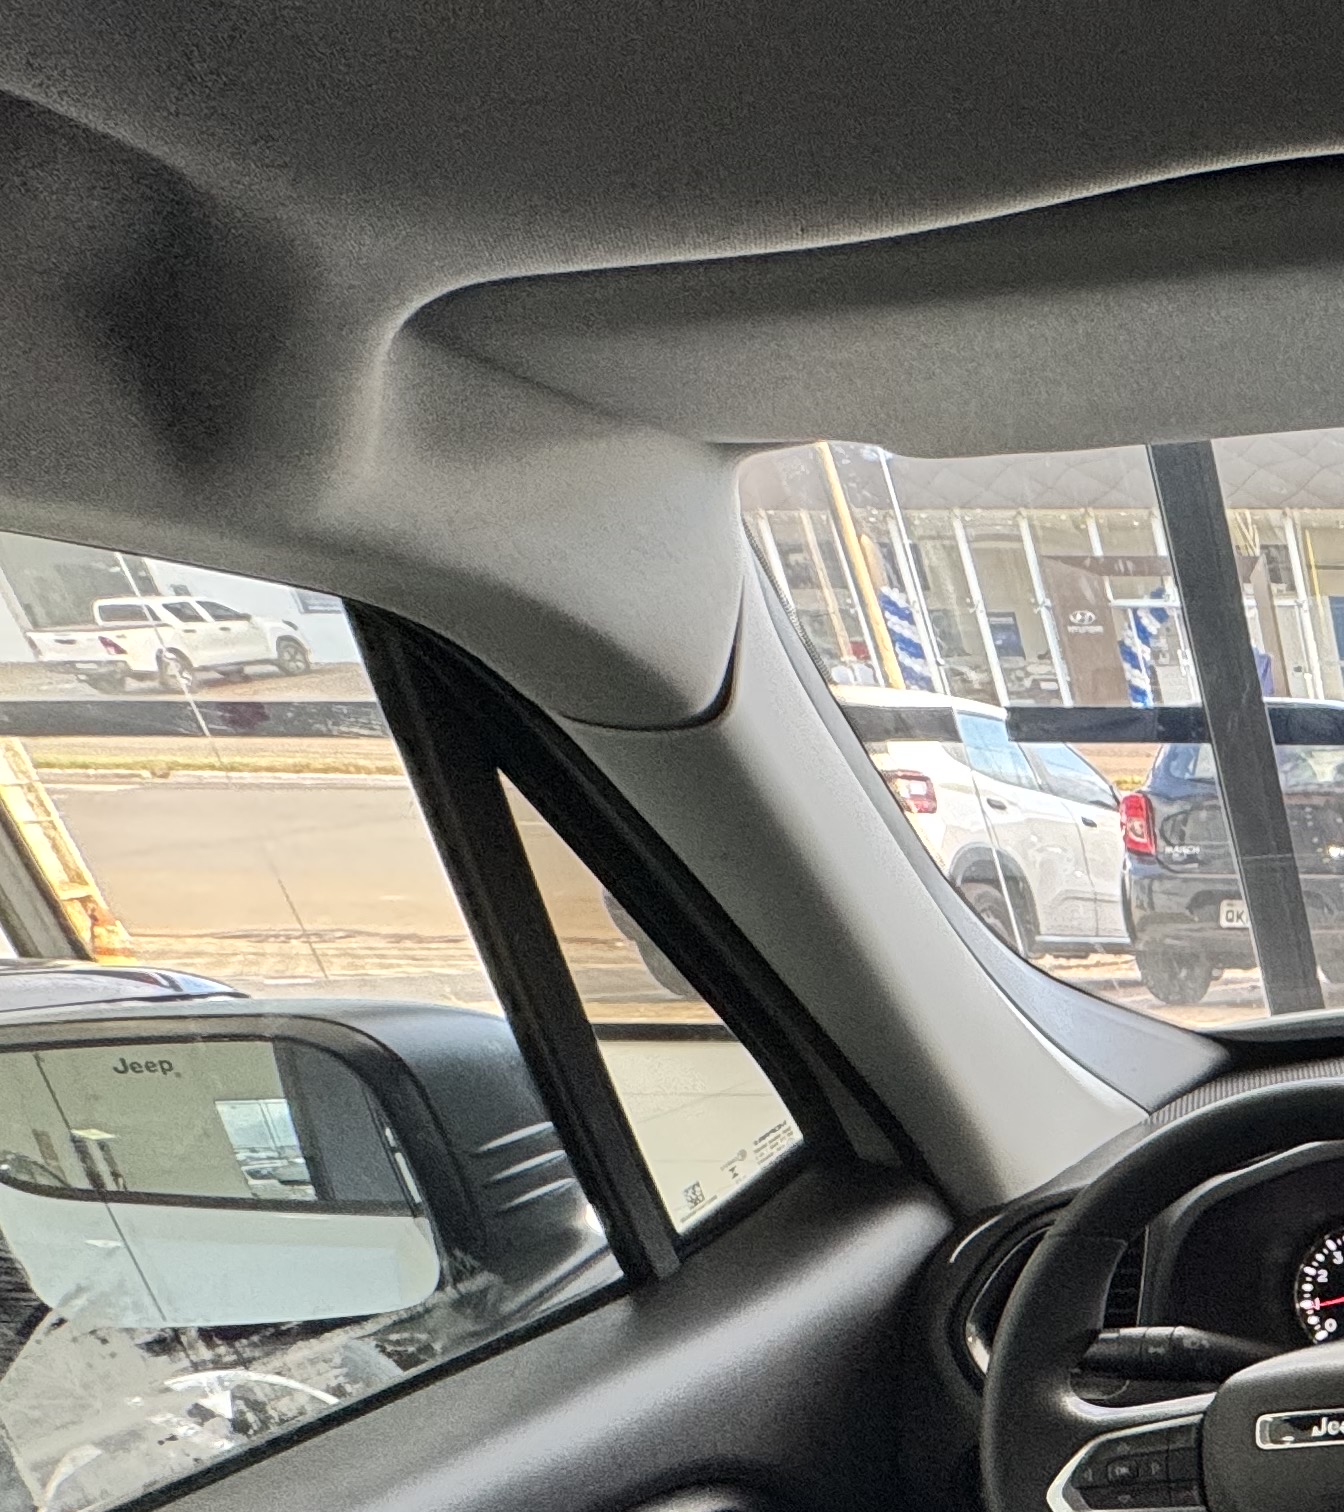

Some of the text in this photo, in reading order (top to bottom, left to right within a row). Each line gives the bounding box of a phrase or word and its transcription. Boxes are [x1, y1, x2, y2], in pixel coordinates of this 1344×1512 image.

[113, 1057, 174, 1076] Jeep
[1317, 1269, 1328, 1283] 2
[1324, 1318, 1338, 1333] 0
